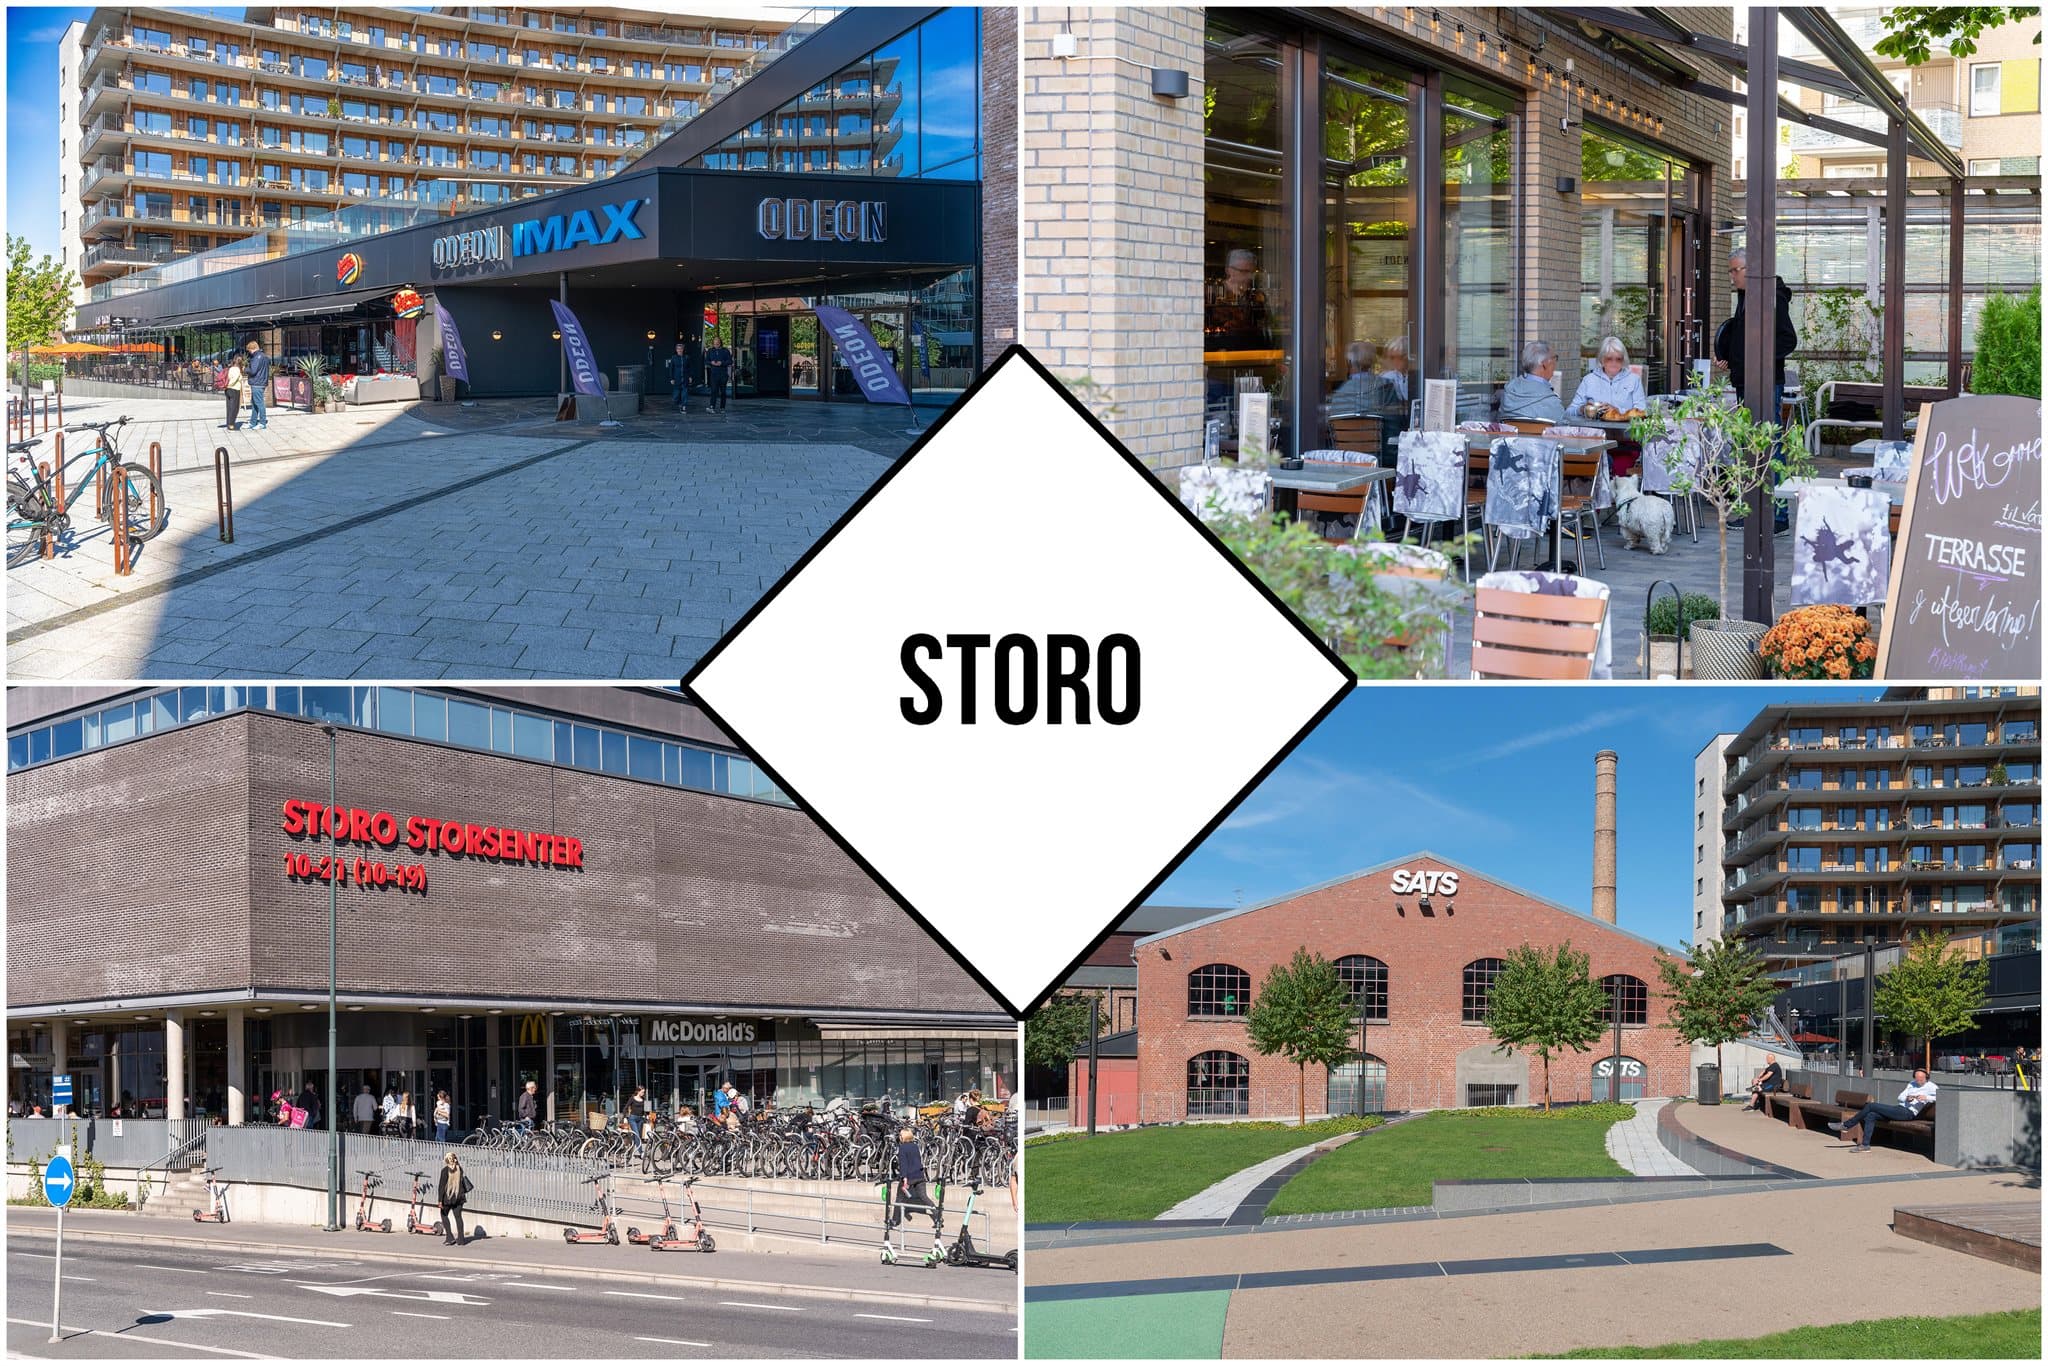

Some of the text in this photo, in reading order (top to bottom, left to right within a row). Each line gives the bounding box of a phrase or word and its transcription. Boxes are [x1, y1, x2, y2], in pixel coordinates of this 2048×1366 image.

[433, 199, 646, 270] ODEON IMAX
[758, 197, 888, 243] ODEON
[442, 321, 462, 371] ODEON
[563, 322, 595, 384] ODEON
[834, 323, 890, 392] ODEON
[1924, 533, 2026, 577] TERRASSE
[283, 798, 584, 867] STORO STORSENTER
[283, 852, 427, 891] 10-21 (10-19)
[1390, 869, 1460, 896] SATS
[651, 1019, 756, 1043] McDonald's
